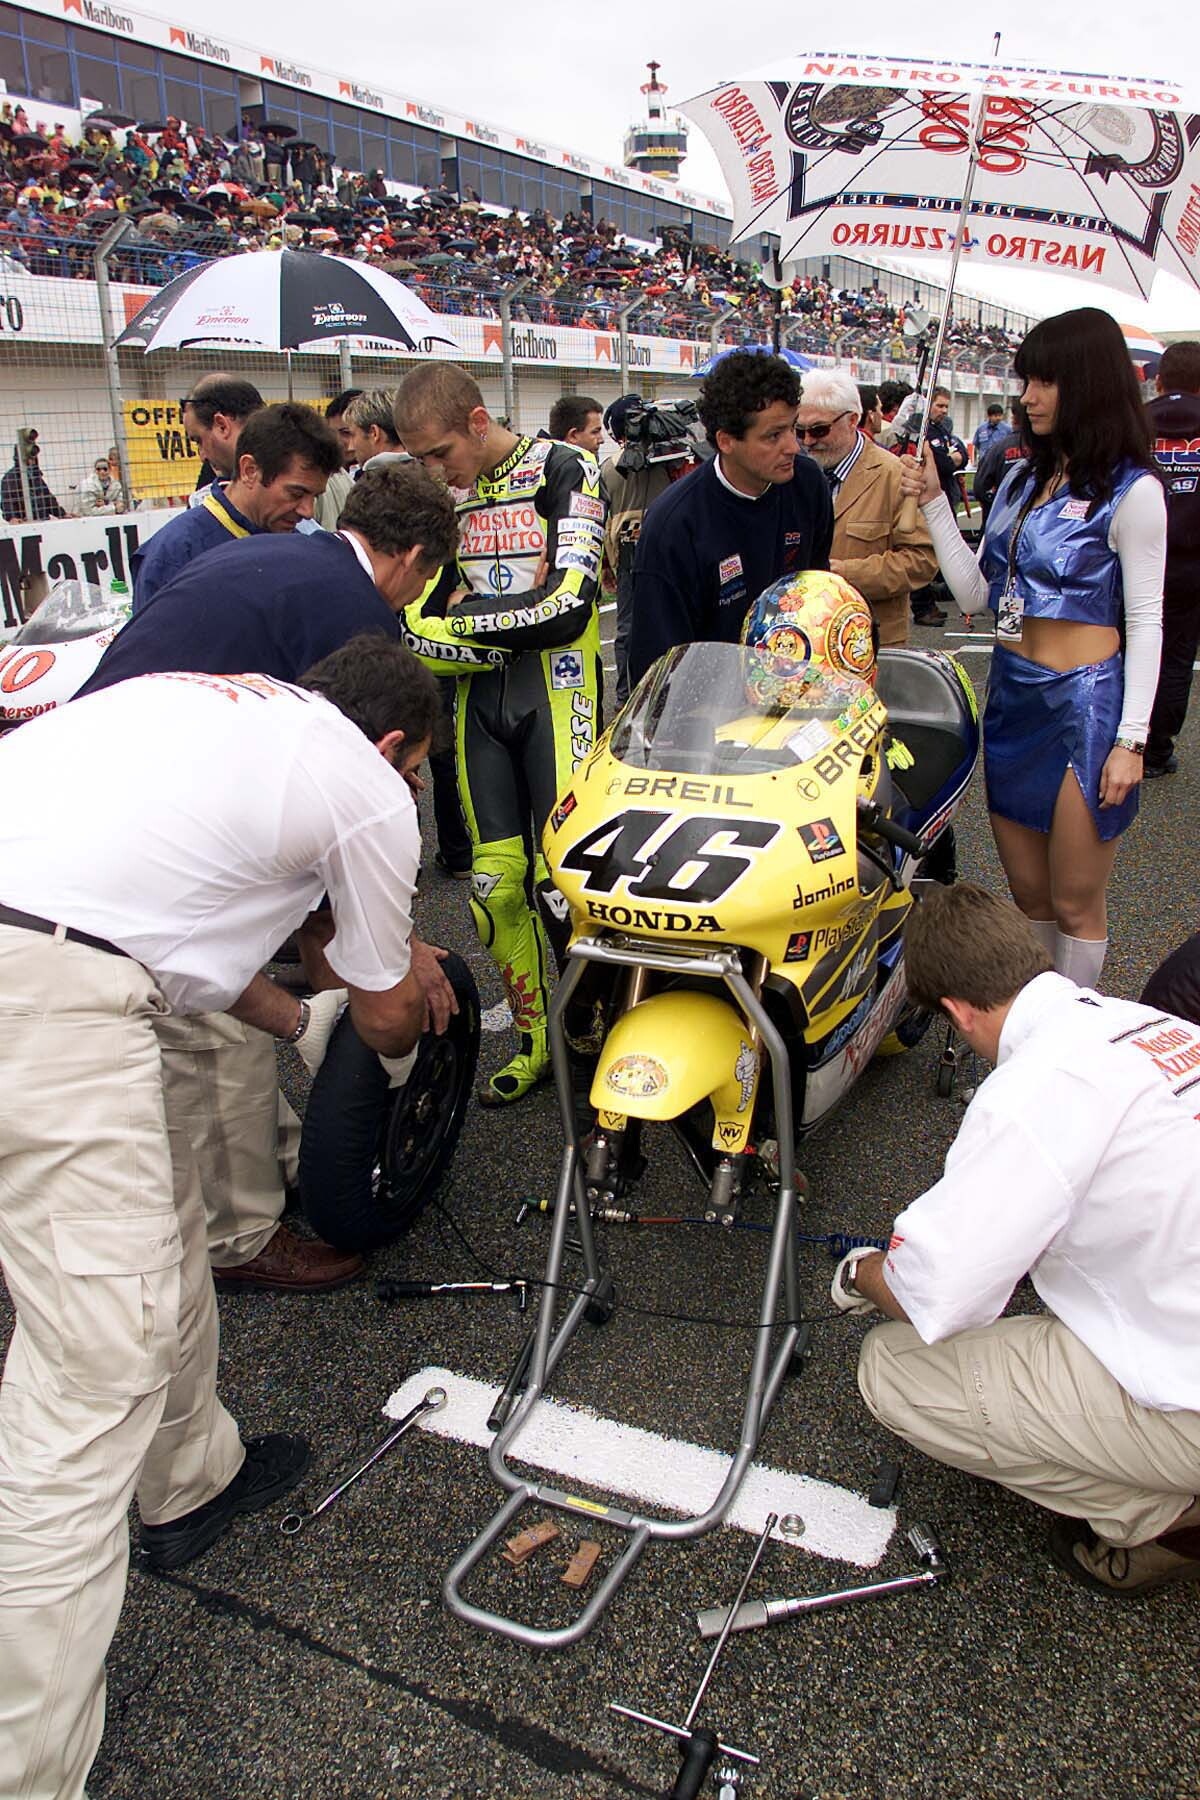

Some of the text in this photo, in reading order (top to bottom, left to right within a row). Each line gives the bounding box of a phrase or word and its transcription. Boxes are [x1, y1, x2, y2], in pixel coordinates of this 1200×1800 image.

[82, 0, 135, 34] Marlboro
[186, 30, 231, 63] Marlboro
[274, 59, 313, 88] Marlboro
[803, 62, 960, 84] NASTRO
[982, 73, 1181, 104] AZZURRO
[351, 83, 384, 109] Marlboro
[195, 314, 249, 326] Emerson
[312, 312, 368, 326] Emerson
[155, 429, 201, 461] VAL
[468, 507, 536, 532] Nastro
[461, 530, 545, 555] Azzurro
[472, 592, 585, 633] HONDA
[0, 701, 57, 719] erson
[813, 713, 883, 786] BREIL
[623, 777, 754, 808] BREIL
[559, 808, 782, 905] 46
[792, 873, 855, 910] domino
[585, 900, 726, 933] HONDA
[1130, 1027, 1194, 1058] Nastro
